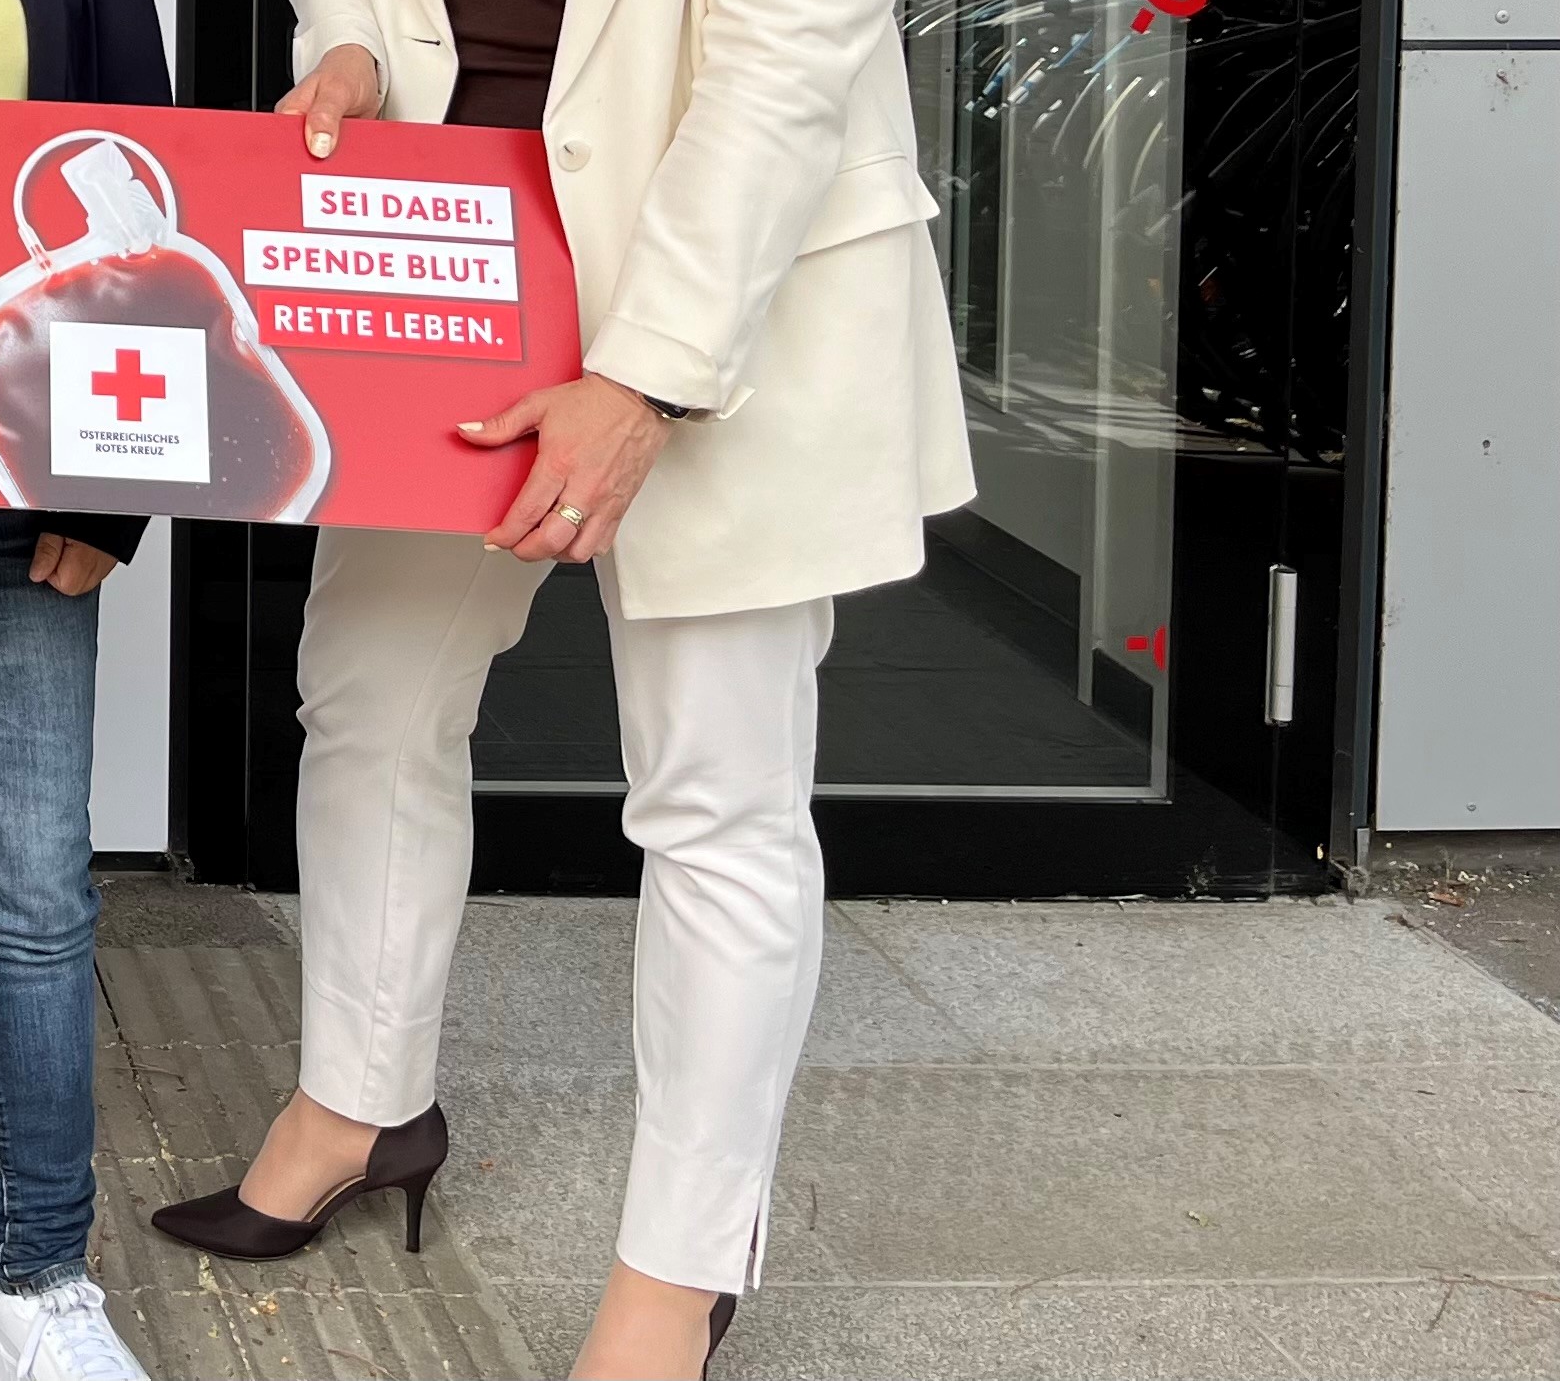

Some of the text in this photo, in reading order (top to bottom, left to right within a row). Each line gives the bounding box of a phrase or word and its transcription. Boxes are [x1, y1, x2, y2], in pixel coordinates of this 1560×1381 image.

[320, 190, 494, 226] SEI DABEI.
[262, 244, 501, 286] SPENDE BLUT.
[273, 303, 505, 346] RETTE LEBEN.
[79, 429, 180, 444] ÖSTERREICHISCHES
[95, 443, 164, 456] ROTES KREUZ
